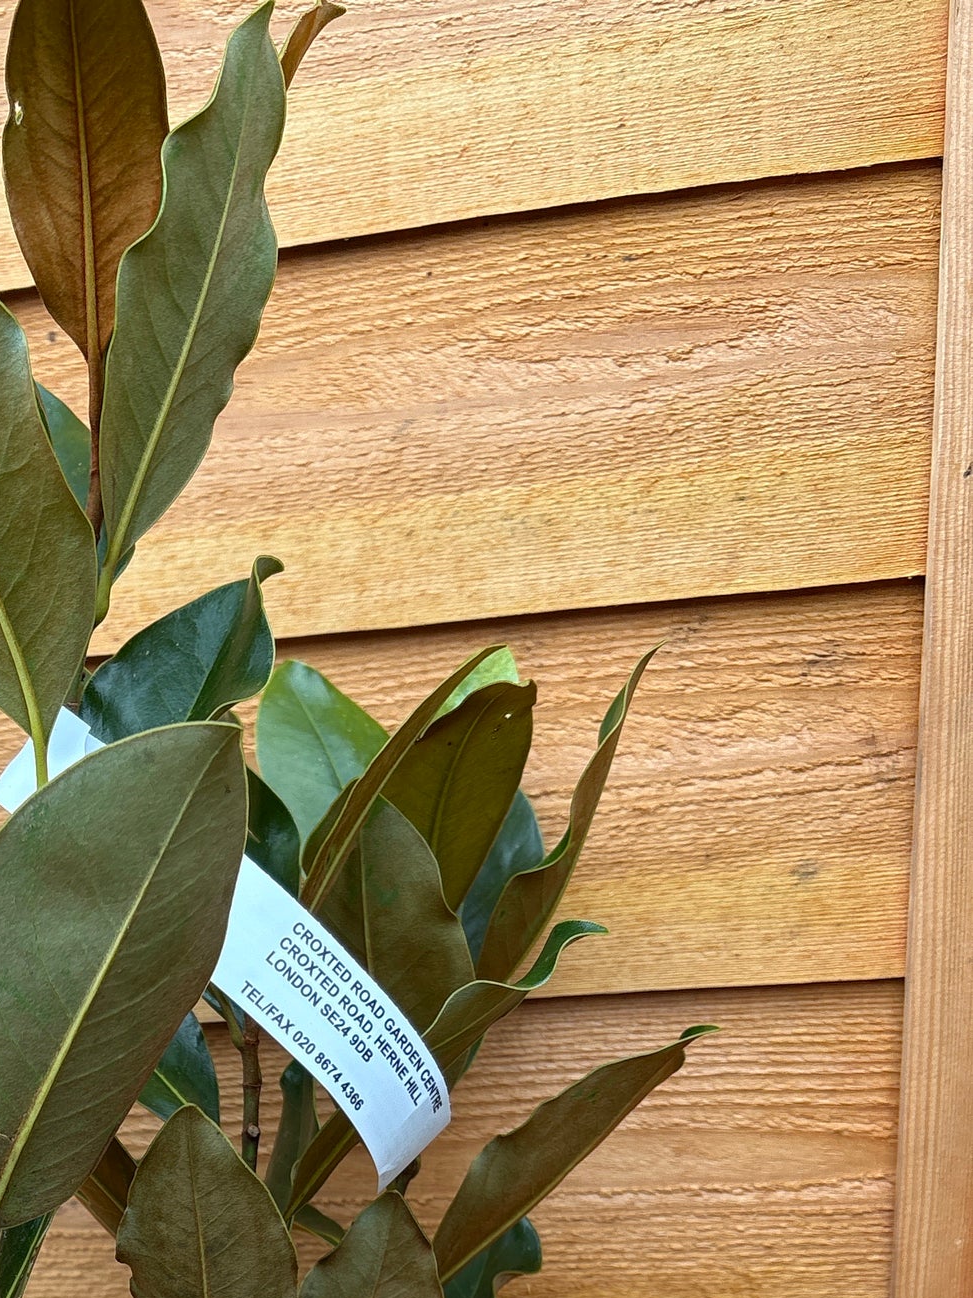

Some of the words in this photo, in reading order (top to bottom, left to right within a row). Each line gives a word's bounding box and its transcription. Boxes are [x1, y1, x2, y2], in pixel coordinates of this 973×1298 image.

[240, 980, 295, 1035] TEL/FAX
[293, 1031, 316, 1056] 020
[315, 1052, 342, 1083] 8674
[340, 1081, 364, 1111] 4366
[265, 950, 322, 1008] LONDON
[320, 1003, 350, 1038] SE24
[349, 1029, 373, 1063] 9DB
[279, 936, 340, 999] CROXTED
[338, 995, 373, 1040] ROAD,
[374, 1034, 409, 1081] HERNE
[404, 1079, 421, 1106] HILL
[293, 921, 352, 983] CROXTED
[350, 979, 386, 1021] ROAD
[384, 1017, 424, 1075] GARDEN
[421, 1069, 443, 1113] CENTRE
